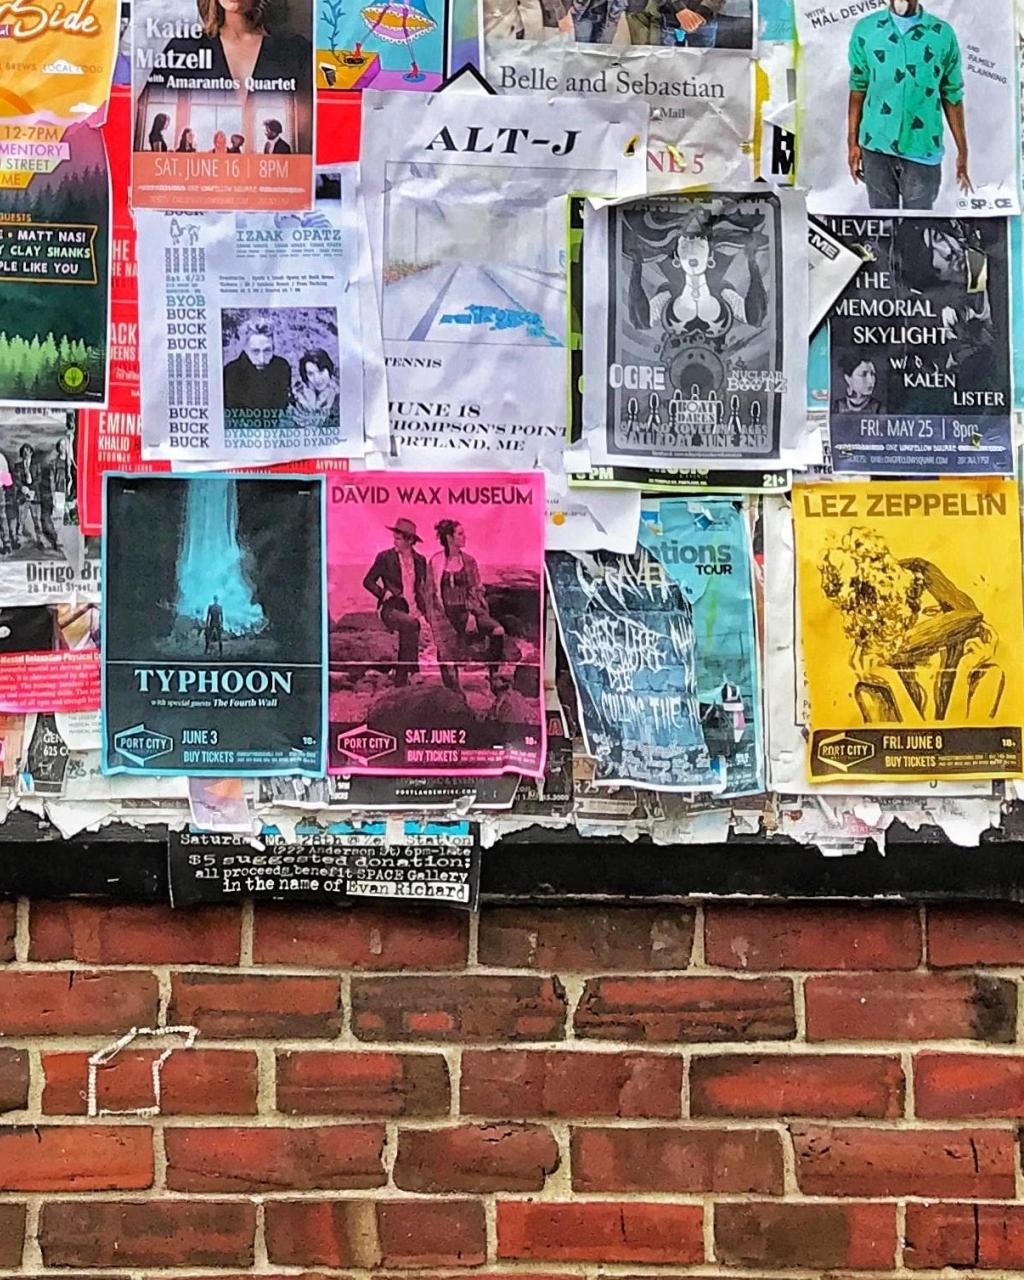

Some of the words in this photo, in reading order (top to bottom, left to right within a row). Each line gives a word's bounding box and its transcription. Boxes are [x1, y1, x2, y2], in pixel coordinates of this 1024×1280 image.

[811, 9, 839, 30] MAL
[147, 18, 202, 39] Katie
[136, 48, 213, 70] Matzell
[166, 76, 240, 90] Amarantos
[244, 77, 296, 91] Quartet
[498, 65, 558, 92] Belle
[565, 68, 608, 93] and
[616, 70, 725, 99] Sebastian
[426, 126, 582, 156] ALT-J
[6, 159, 50, 171] STREET
[155, 158, 182, 178] SAT.
[184, 159, 218, 180] JUNE
[226, 159, 240, 178] 16
[259, 160, 288, 178] 8PM
[23, 261, 47, 273] LIKE
[54, 262, 79, 274] YOU
[167, 309, 206, 320] BUCK
[835, 299, 936, 317] MEMORIAL
[167, 324, 206, 335] BUCK
[853, 327, 948, 345] SKYLIGHT
[168, 338, 207, 350] BUCK
[610, 364, 666, 391] OGRE
[904, 374, 956, 388] KALEN
[953, 392, 1004, 406] LISTER
[169, 408, 208, 420] BUCK
[169, 423, 209, 434] BUCK
[332, 486, 389, 504] DAVID
[398, 486, 441, 505] WAX
[447, 485, 533, 505] MUSEUM
[804, 494, 858, 518] LEZ
[866, 493, 1007, 517] ZEPPELIN
[26, 563, 75, 583] Dirigo
[695, 564, 733, 576] TOUR
[134, 669, 293, 694] TYPHOON
[405, 730, 428, 744] SAT.
[431, 730, 455, 744] JUNE
[458, 730, 466, 744] 2
[882, 735, 904, 750] FRI.
[906, 736, 932, 750] JUNE
[935, 736, 943, 750] 8
[183, 750, 202, 763] BUY
[203, 750, 234, 763] TICKETS
[885, 755, 905, 768] BUY
[907, 755, 936, 768] TICKETS
[195, 868, 220, 879] all
[294, 867, 354, 880] benefit
[357, 869, 404, 881] SPACE
[407, 870, 468, 885] Gallery
[223, 879, 242, 893] in
[245, 878, 275, 892] the
[278, 879, 319, 892] name
[323, 878, 343, 892] of
[347, 881, 391, 895] Evan
[394, 883, 467, 901] Richard
